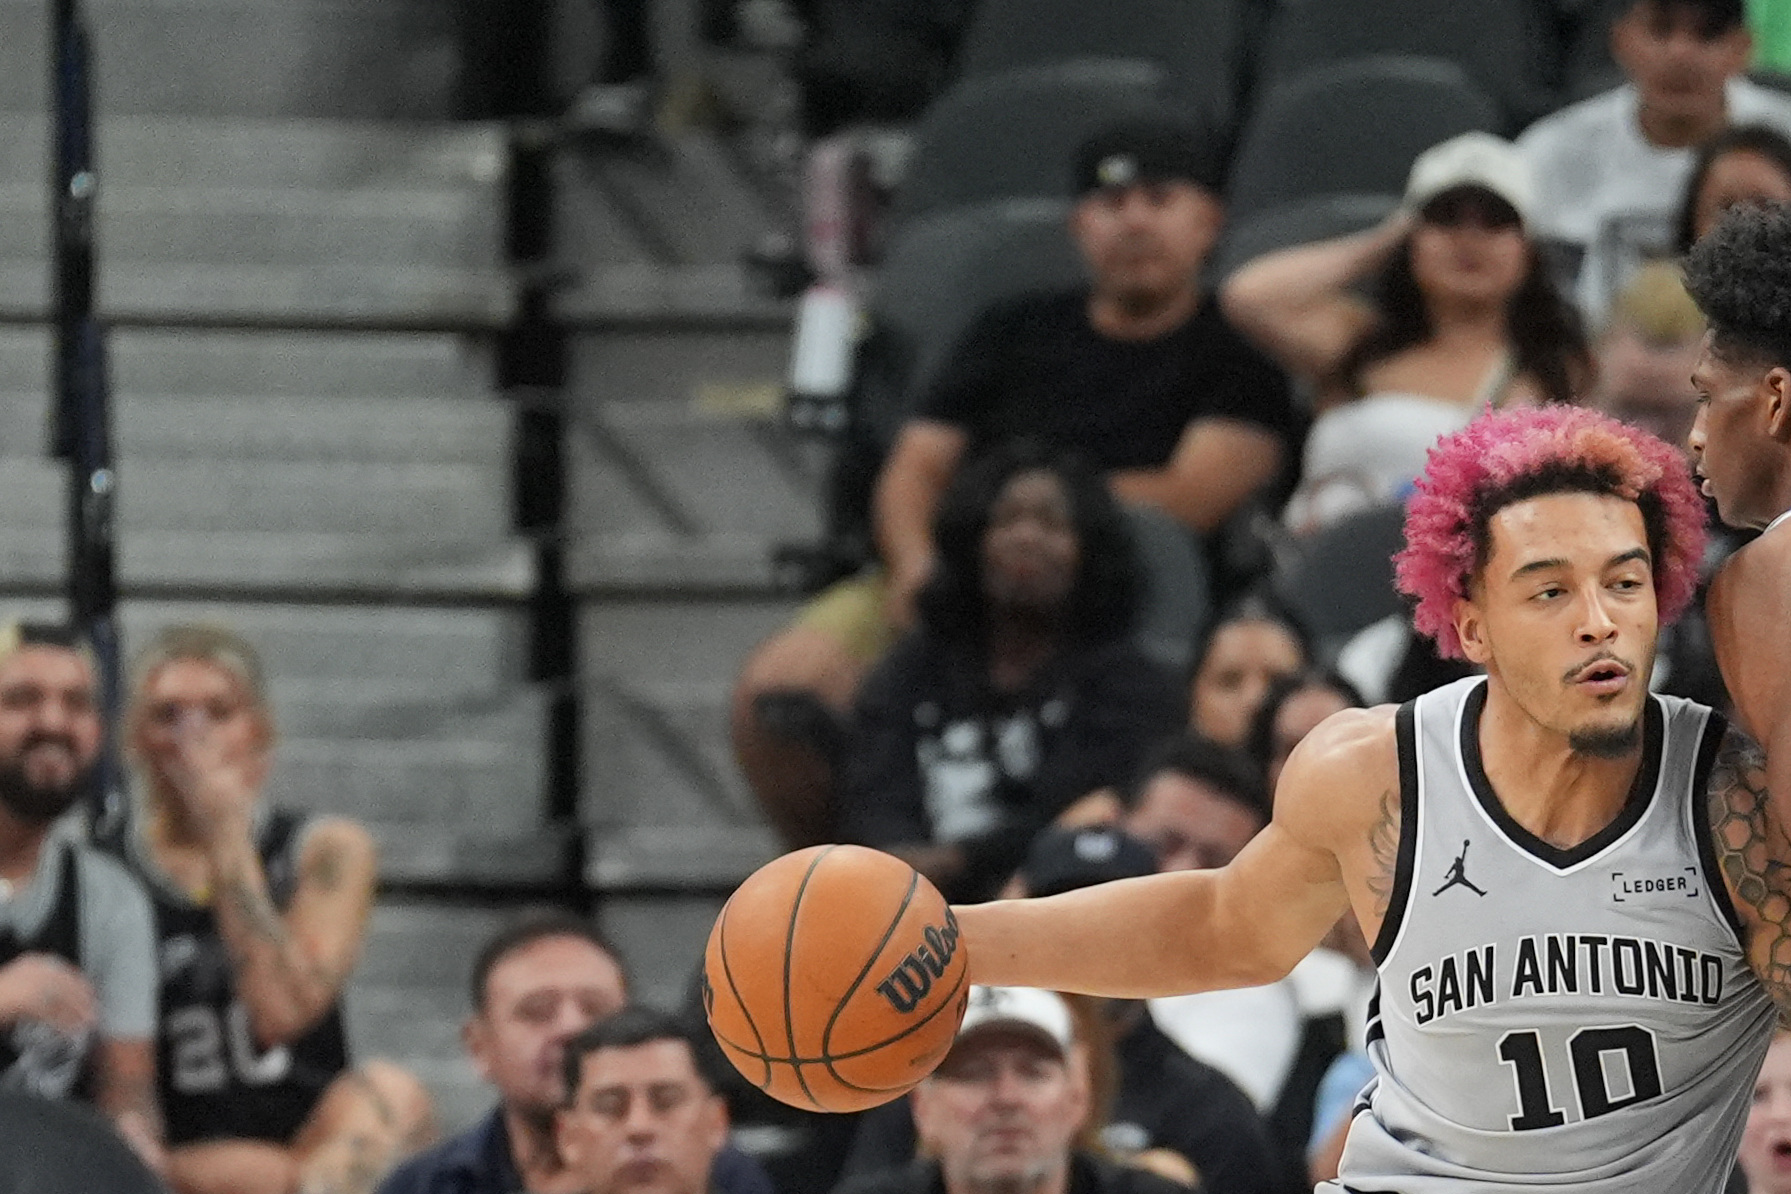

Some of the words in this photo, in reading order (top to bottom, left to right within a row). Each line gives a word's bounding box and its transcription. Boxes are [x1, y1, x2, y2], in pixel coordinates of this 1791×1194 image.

[1623, 876, 1687, 893] LEDGER
[1408, 942, 1497, 1028] SAN
[1510, 933, 1724, 1005] ANTONIO
[1495, 1022, 1665, 1132] 10
